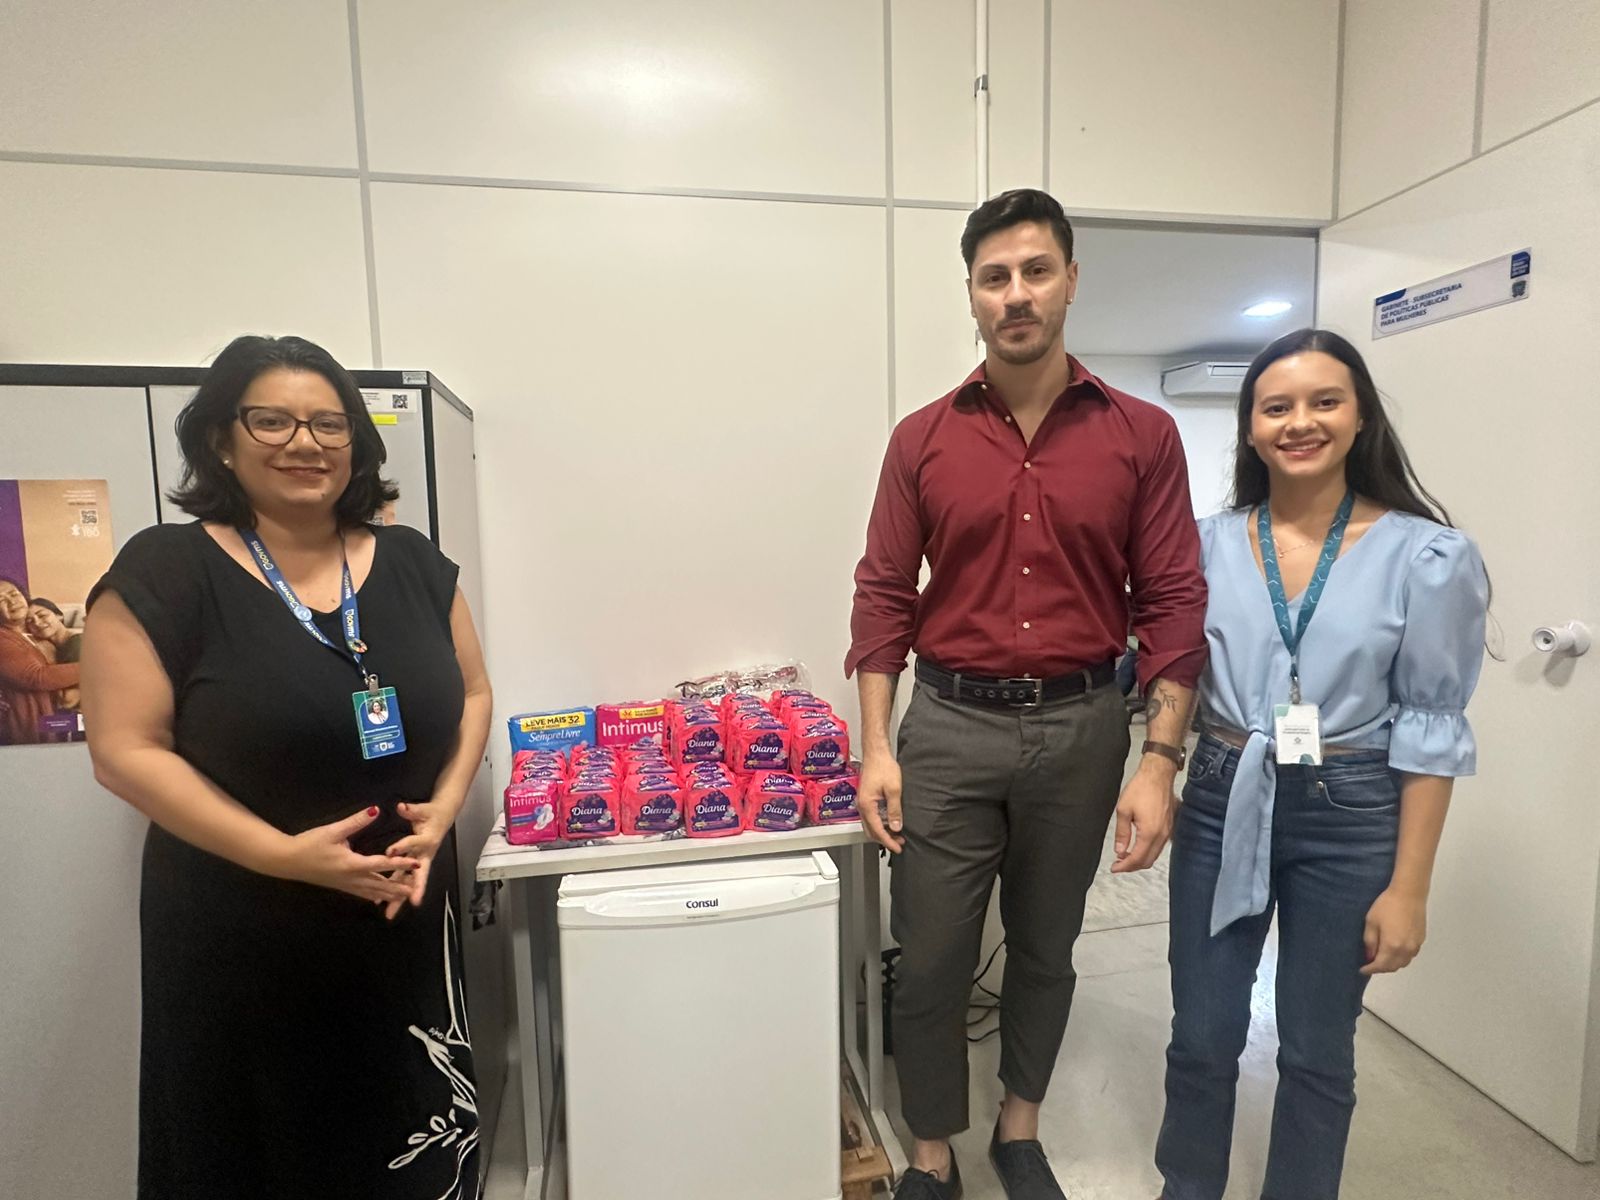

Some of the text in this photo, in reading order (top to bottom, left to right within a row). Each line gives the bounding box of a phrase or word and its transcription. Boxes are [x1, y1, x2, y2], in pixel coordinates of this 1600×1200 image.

[1381, 312, 1389, 320] DE
[1381, 318, 1395, 327] PARA
[525, 718, 546, 728] LEVE
[547, 717, 567, 725] MAIS
[567, 715, 580, 725] 32
[602, 719, 663, 737] Intimus
[688, 739, 715, 748] Diana
[750, 744, 778, 753] Diana
[807, 750, 836, 759] Diana
[823, 794, 852, 804] Diana
[571, 806, 603, 816] Diana
[642, 806, 672, 815] Diana
[695, 803, 726, 814] Diana
[763, 803, 793, 816] Diana
